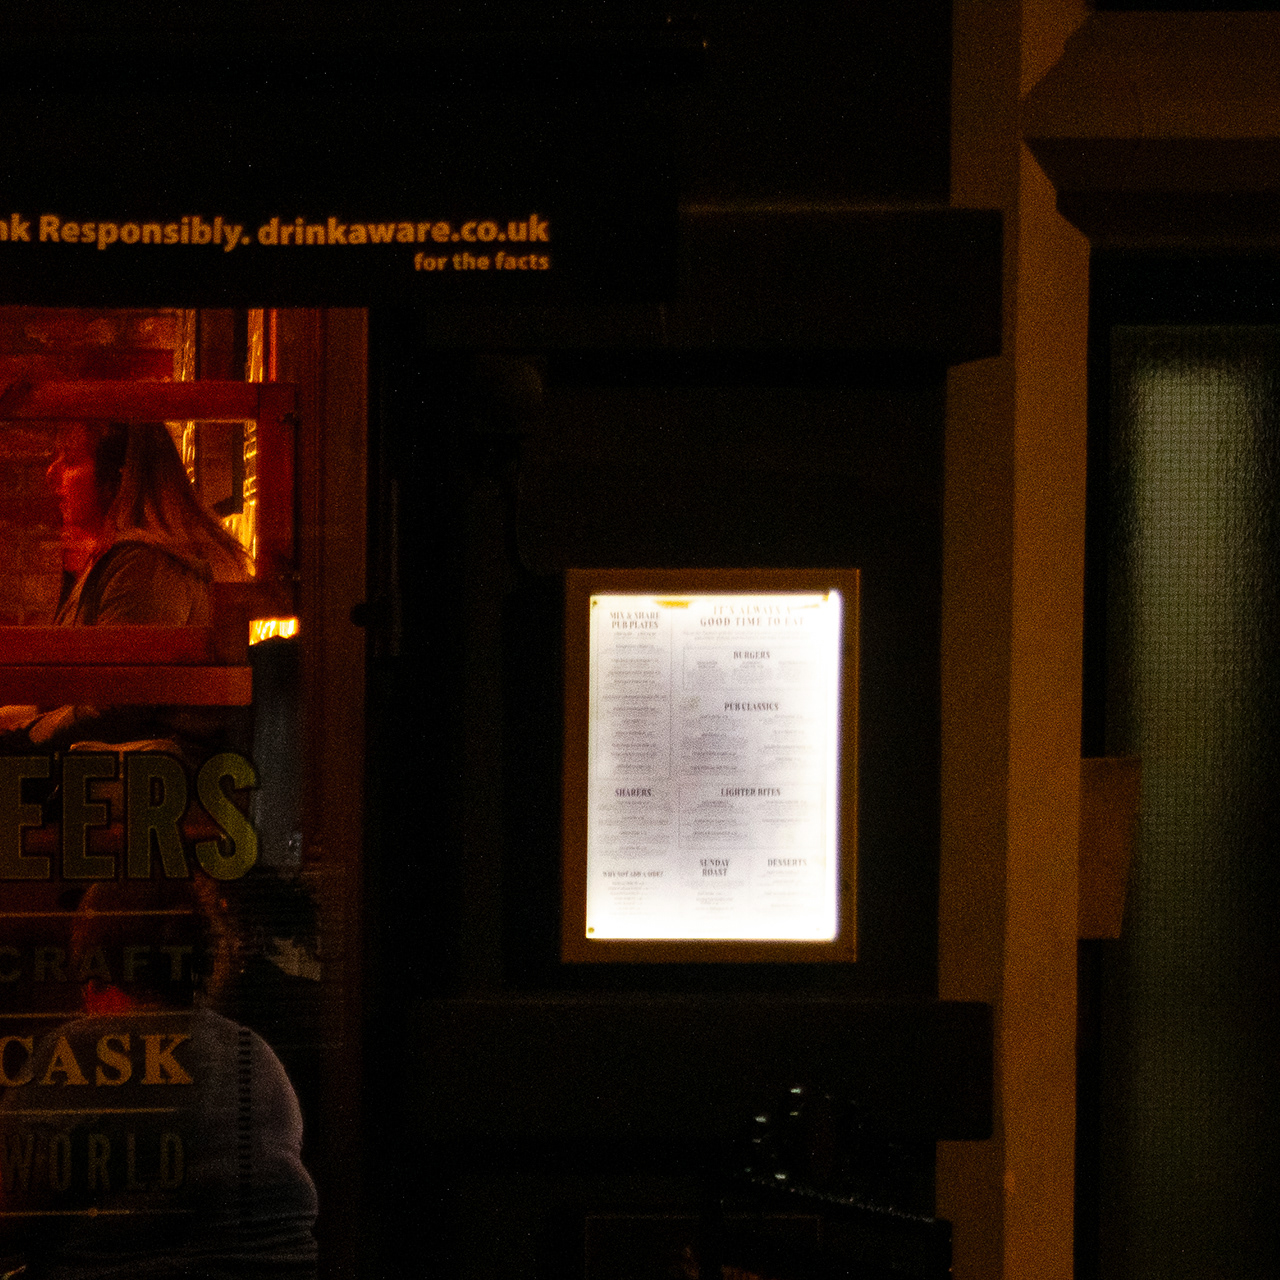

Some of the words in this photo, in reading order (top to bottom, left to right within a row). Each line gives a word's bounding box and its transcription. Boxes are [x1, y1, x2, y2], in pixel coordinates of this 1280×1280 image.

[39, 214, 252, 253] Responsibly.
[257, 213, 551, 245] drinkaware.co.uk
[413, 251, 448, 271] for
[452, 251, 489, 271] the
[494, 251, 552, 271] facts
[611, 620, 628, 630] PUB
[629, 620, 659, 629] PLATES
[699, 617, 731, 627] GOOD
[736, 617, 762, 627] TIME
[767, 617, 781, 627] TO
[733, 651, 771, 660] BURGERS
[724, 702, 741, 712] PUB
[741, 702, 780, 712] CLASSICS
[615, 788, 652, 798] SHARERS
[720, 787, 756, 797] LIGHTER
[757, 787, 781, 797] BITES
[699, 858, 731, 867] SUNDAY
[767, 857, 807, 867] DESSERTS
[702, 868, 728, 877] ROAST
